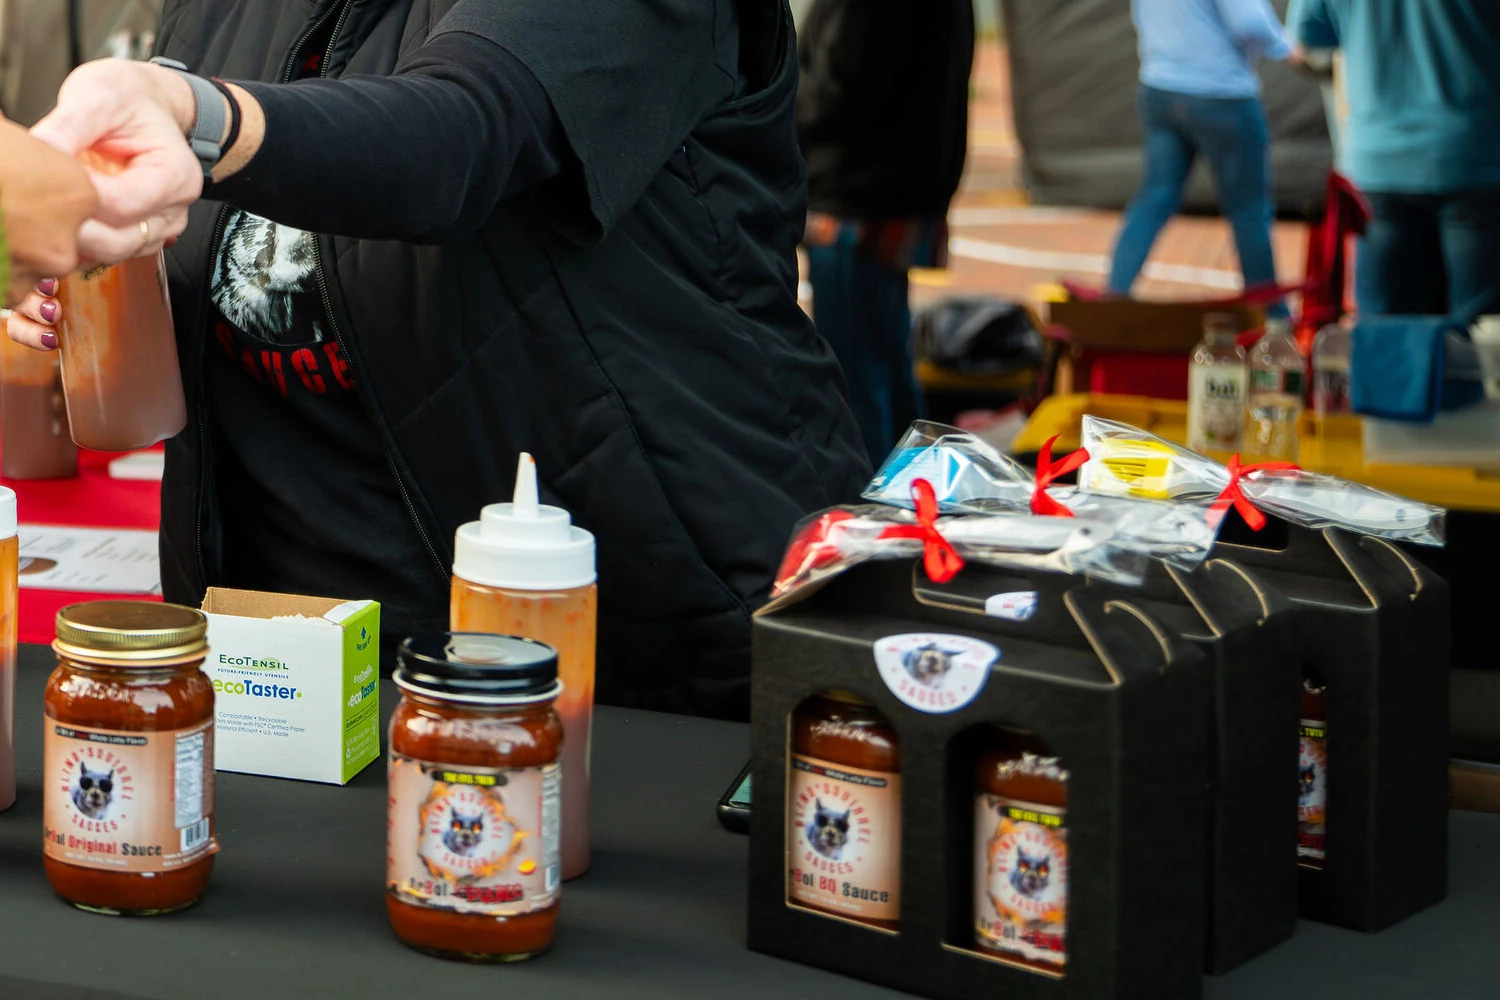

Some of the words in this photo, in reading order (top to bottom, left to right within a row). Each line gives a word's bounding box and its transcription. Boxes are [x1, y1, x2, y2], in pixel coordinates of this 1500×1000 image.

[217, 667, 263, 677] FUTURE-FRIENDLY
[264, 672, 290, 680] UTENSILS
[60, 751, 80, 793] BLIND
[86, 746, 135, 801] SQUIRREL
[71, 813, 119, 833] SAUCES
[67, 834, 117, 855] Original
[121, 842, 163, 857] Sauce
[841, 881, 889, 904] Sauce
